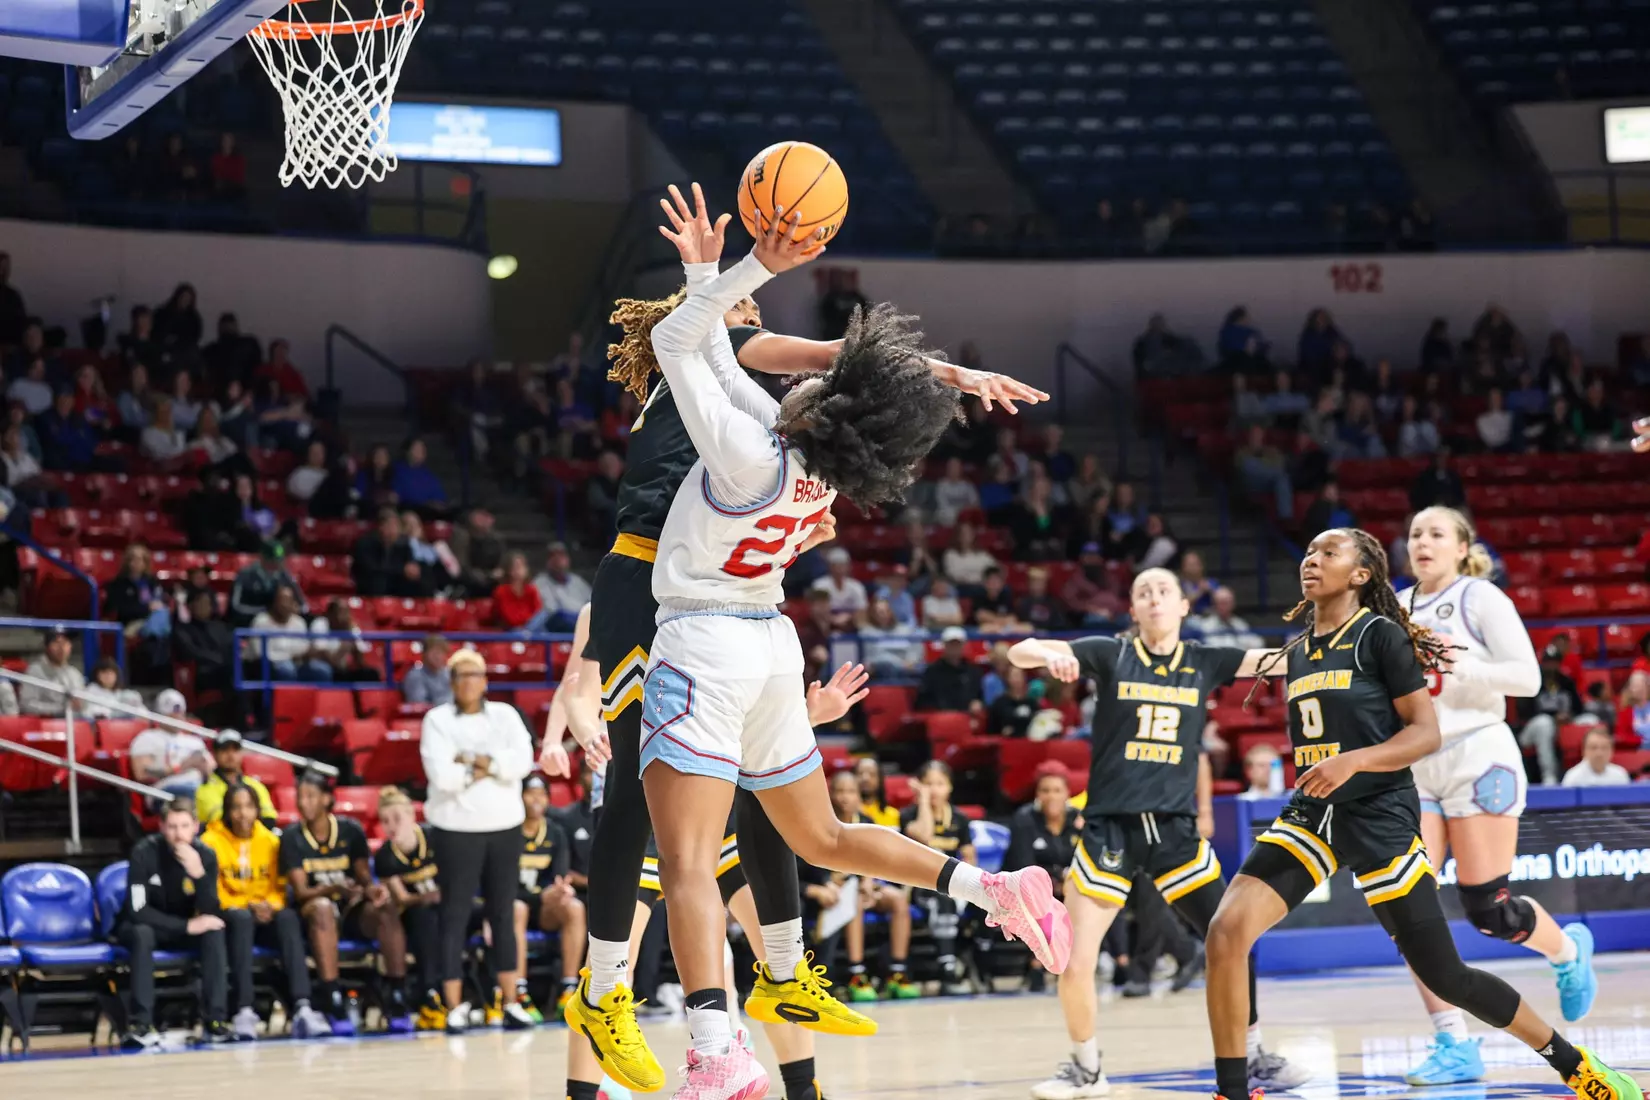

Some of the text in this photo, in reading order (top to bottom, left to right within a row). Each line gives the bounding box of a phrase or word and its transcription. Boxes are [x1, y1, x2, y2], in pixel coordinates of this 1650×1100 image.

[1330, 263, 1384, 294] 102
[1135, 703, 1181, 742] 12
[1297, 697, 1324, 739] 0
[1124, 741, 1183, 765] STATE
[1294, 742, 1340, 767] STATE
